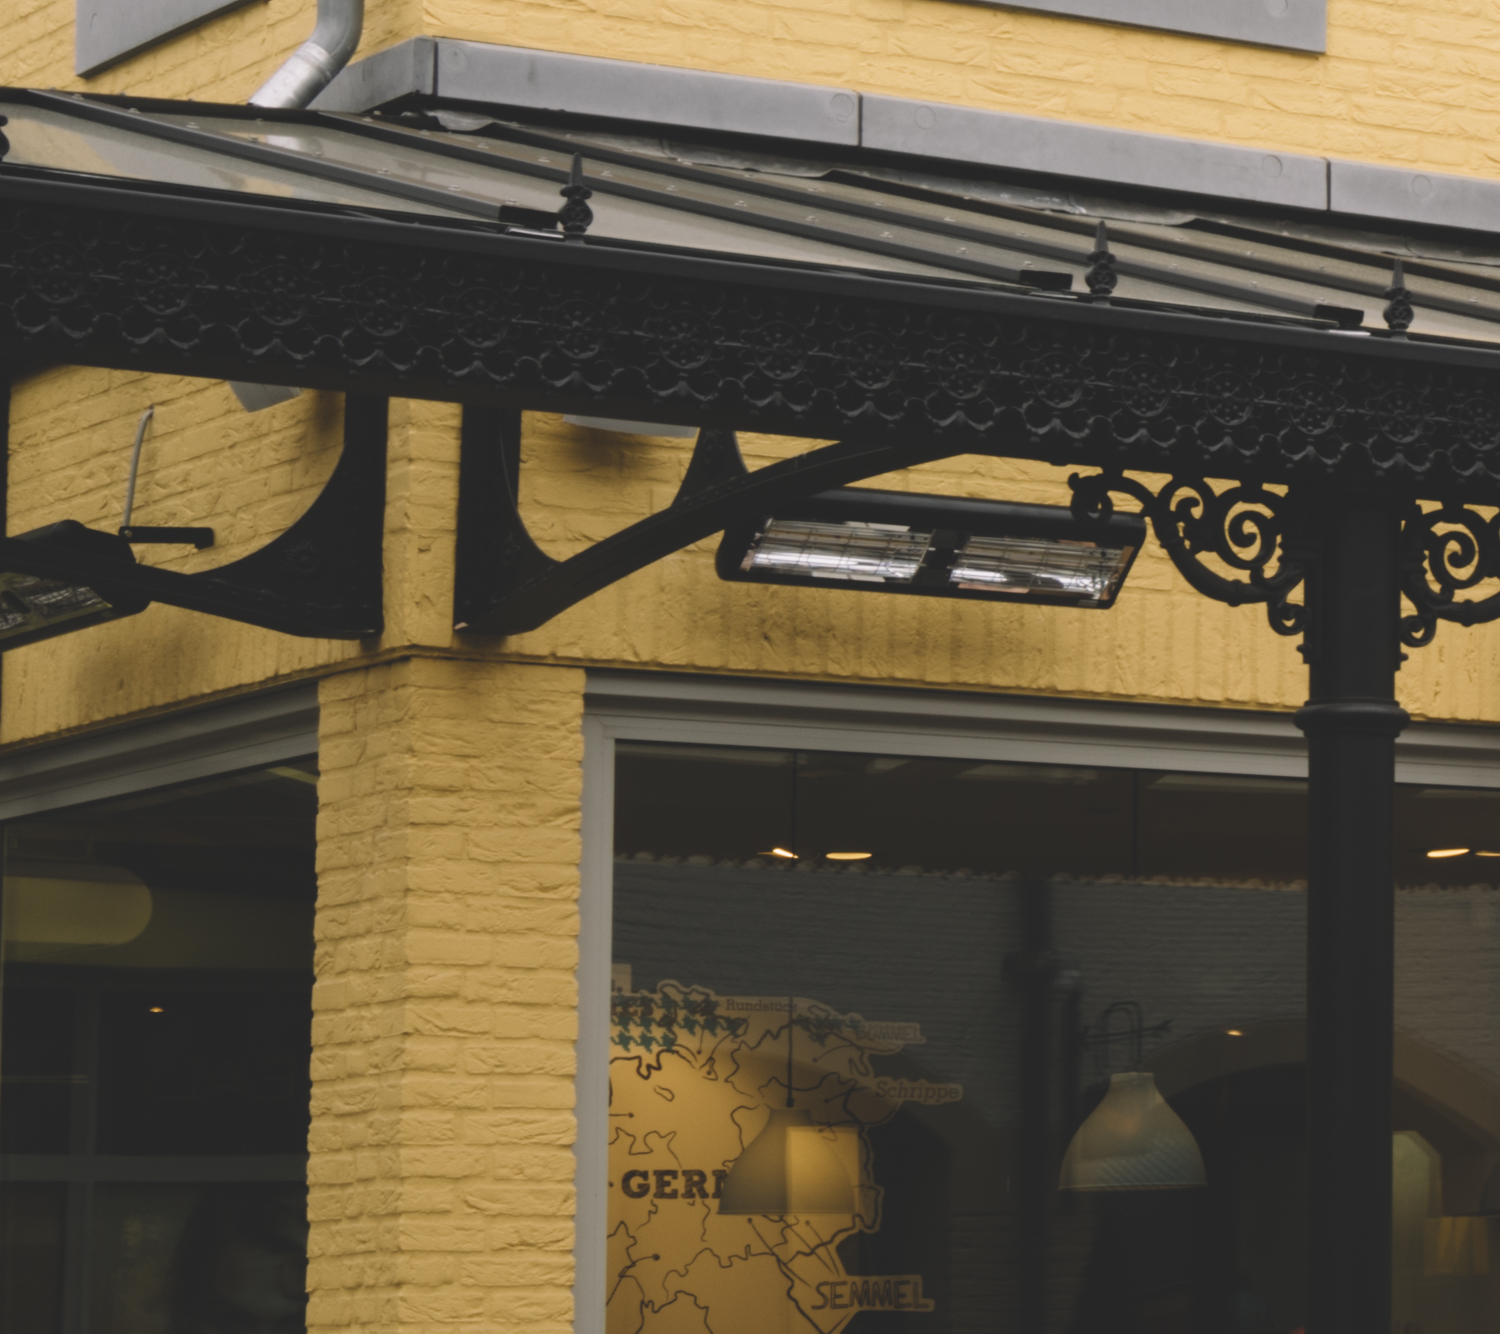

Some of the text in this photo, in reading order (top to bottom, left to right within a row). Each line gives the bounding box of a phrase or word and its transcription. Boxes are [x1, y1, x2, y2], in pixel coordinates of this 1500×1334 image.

[726, 997, 798, 1013] Rundstück
[875, 1080, 961, 1104] Schrippe
[811, 1280, 930, 1310] SEMMEL
